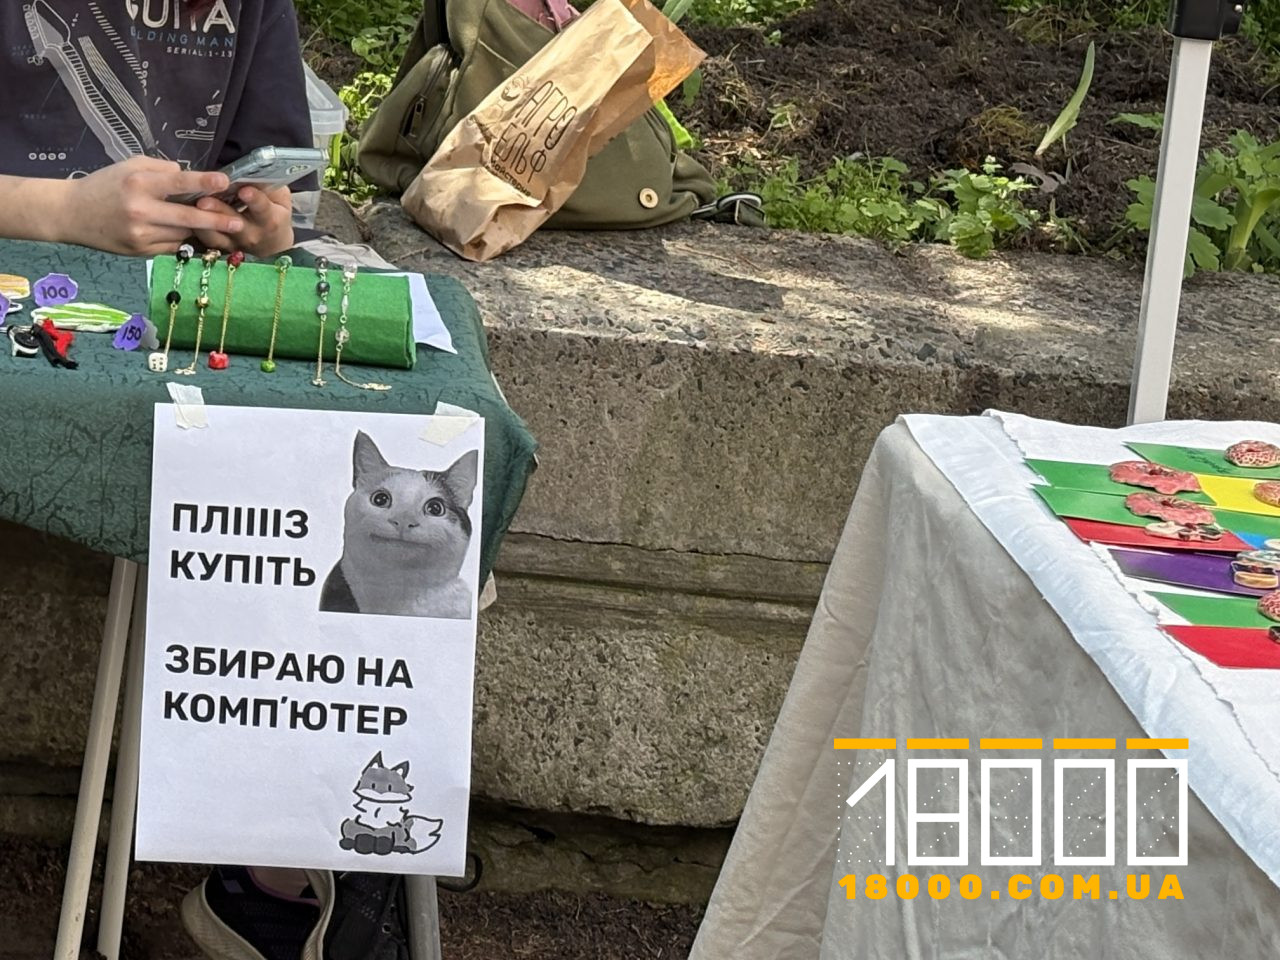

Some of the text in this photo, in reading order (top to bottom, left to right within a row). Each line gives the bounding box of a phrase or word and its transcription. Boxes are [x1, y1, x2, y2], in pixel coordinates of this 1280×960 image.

[515, 80, 577, 150] АГРО
[40, 285, 69, 300] 100
[122, 323, 142, 341] 150
[172, 503, 309, 539] ПЛІІІІЗ
[170, 550, 316, 587] КУПІТЬ
[165, 644, 413, 689] ЗБИРАЮ НА
[164, 691, 408, 736] КОМП'ЮТЕР
